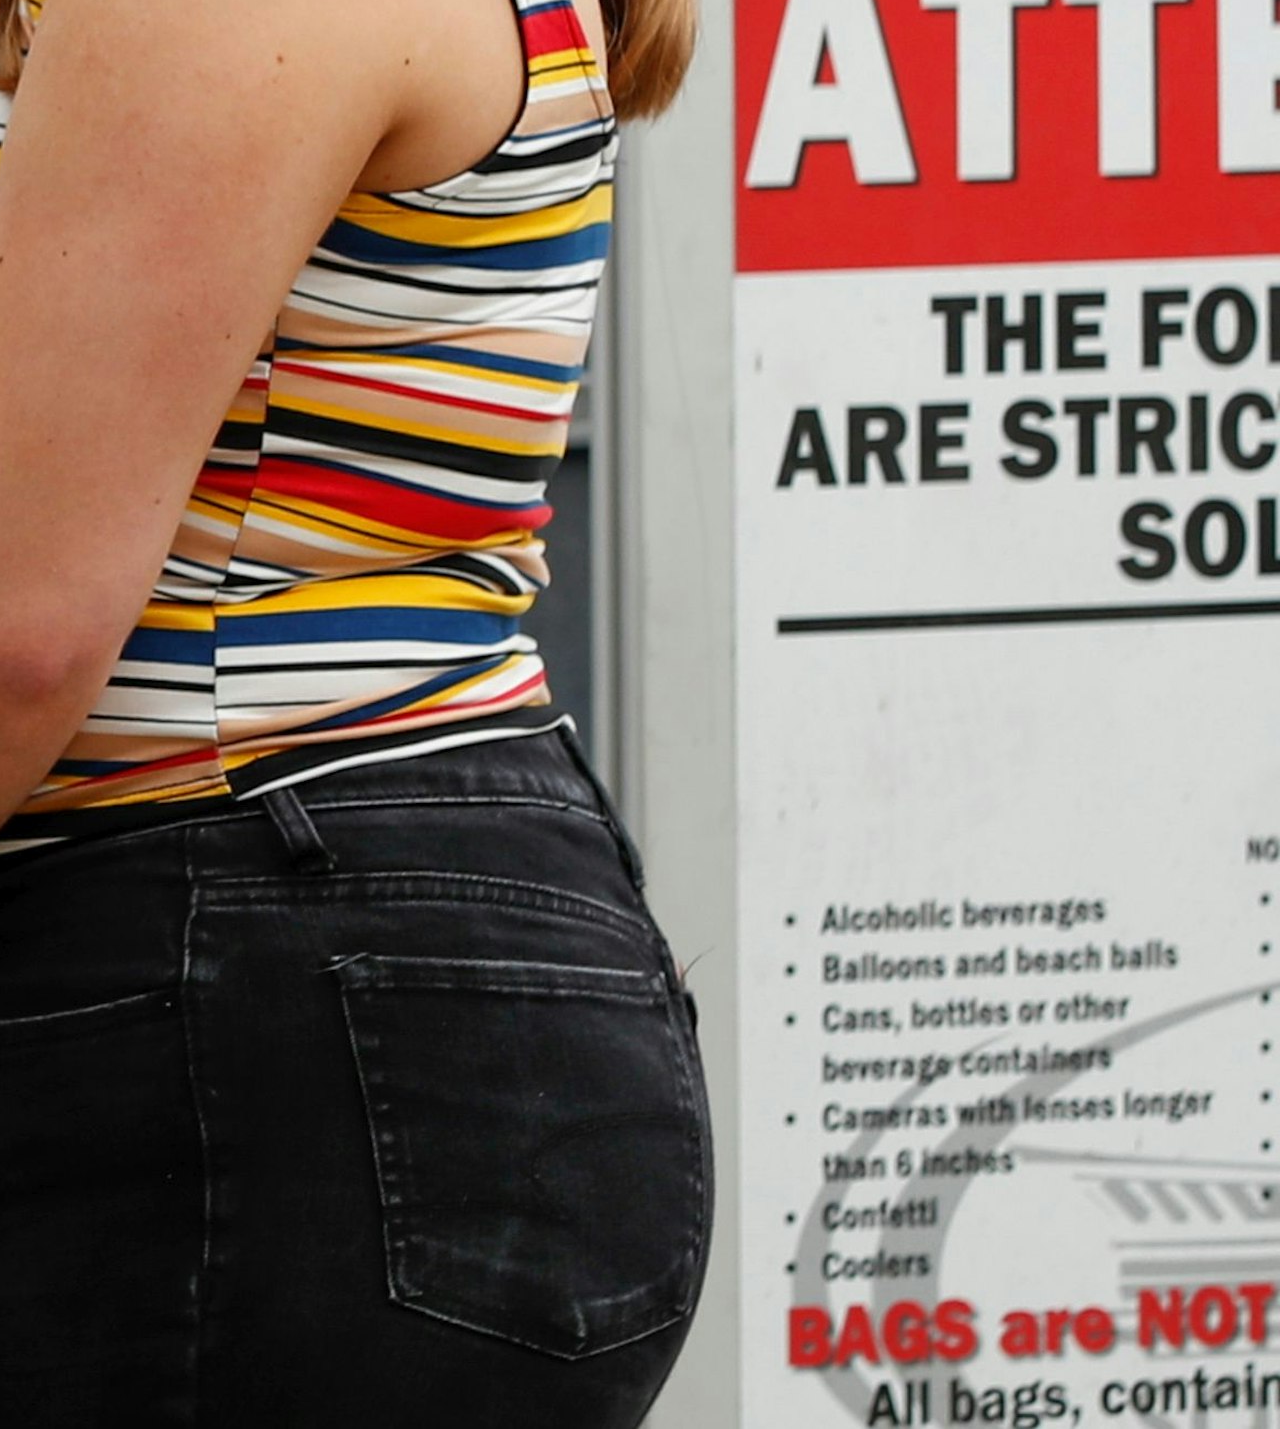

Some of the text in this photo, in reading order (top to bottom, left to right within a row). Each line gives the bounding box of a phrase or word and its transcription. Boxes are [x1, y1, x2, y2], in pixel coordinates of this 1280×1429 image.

[931, 285, 1280, 375] THE FO
[775, 390, 1280, 489] ARE STRIC
[821, 896, 1107, 935] Alcoholic beverages
[822, 940, 1179, 984] Balloons and beach balls
[822, 992, 1131, 1036] Cans, bottles or other
[822, 1043, 1113, 1090] beverage containers
[822, 1087, 1215, 1133] Cameras with lenses longer
[822, 1146, 1016, 1184] than 6 inches
[822, 1197, 939, 1232] Confetti
[822, 1247, 932, 1281] Coolers
[788, 1282, 1277, 1367] BAGS are NOT
[868, 1377, 931, 1428] All
[949, 1376, 1082, 1429] bags,
